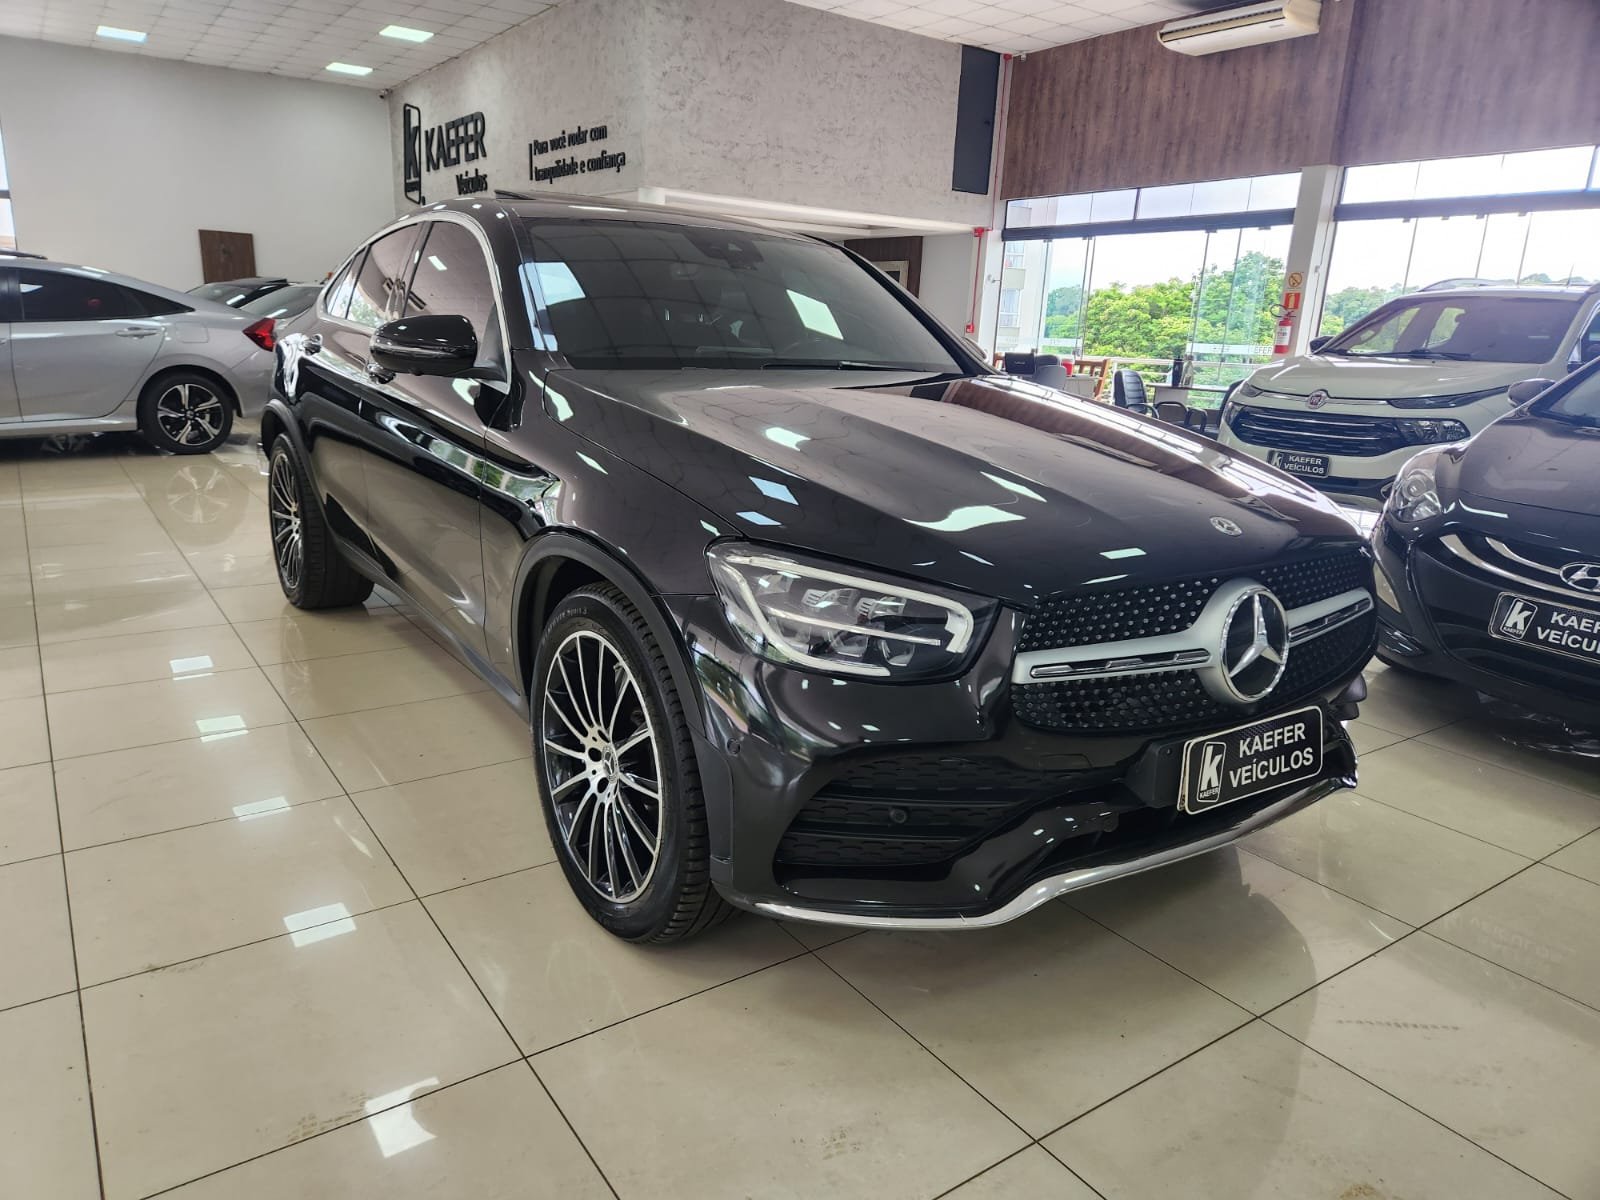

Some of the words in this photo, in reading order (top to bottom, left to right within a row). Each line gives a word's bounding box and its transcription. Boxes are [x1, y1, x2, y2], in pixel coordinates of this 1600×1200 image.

[425, 111, 487, 172] KAEFER
[533, 139, 549, 156] Para
[550, 130, 568, 151] você
[568, 125, 589, 148] rodar
[590, 124, 608, 141] com
[580, 160, 586, 173] e
[587, 150, 626, 172] confiança
[1284, 462, 1325, 474] VEÍCULOS
[1288, 455, 1322, 465] KAEFER
[1239, 722, 1306, 759] KAEFER
[1229, 747, 1314, 788] VEÍCULOS
[1199, 787, 1219, 799] KAEFER
